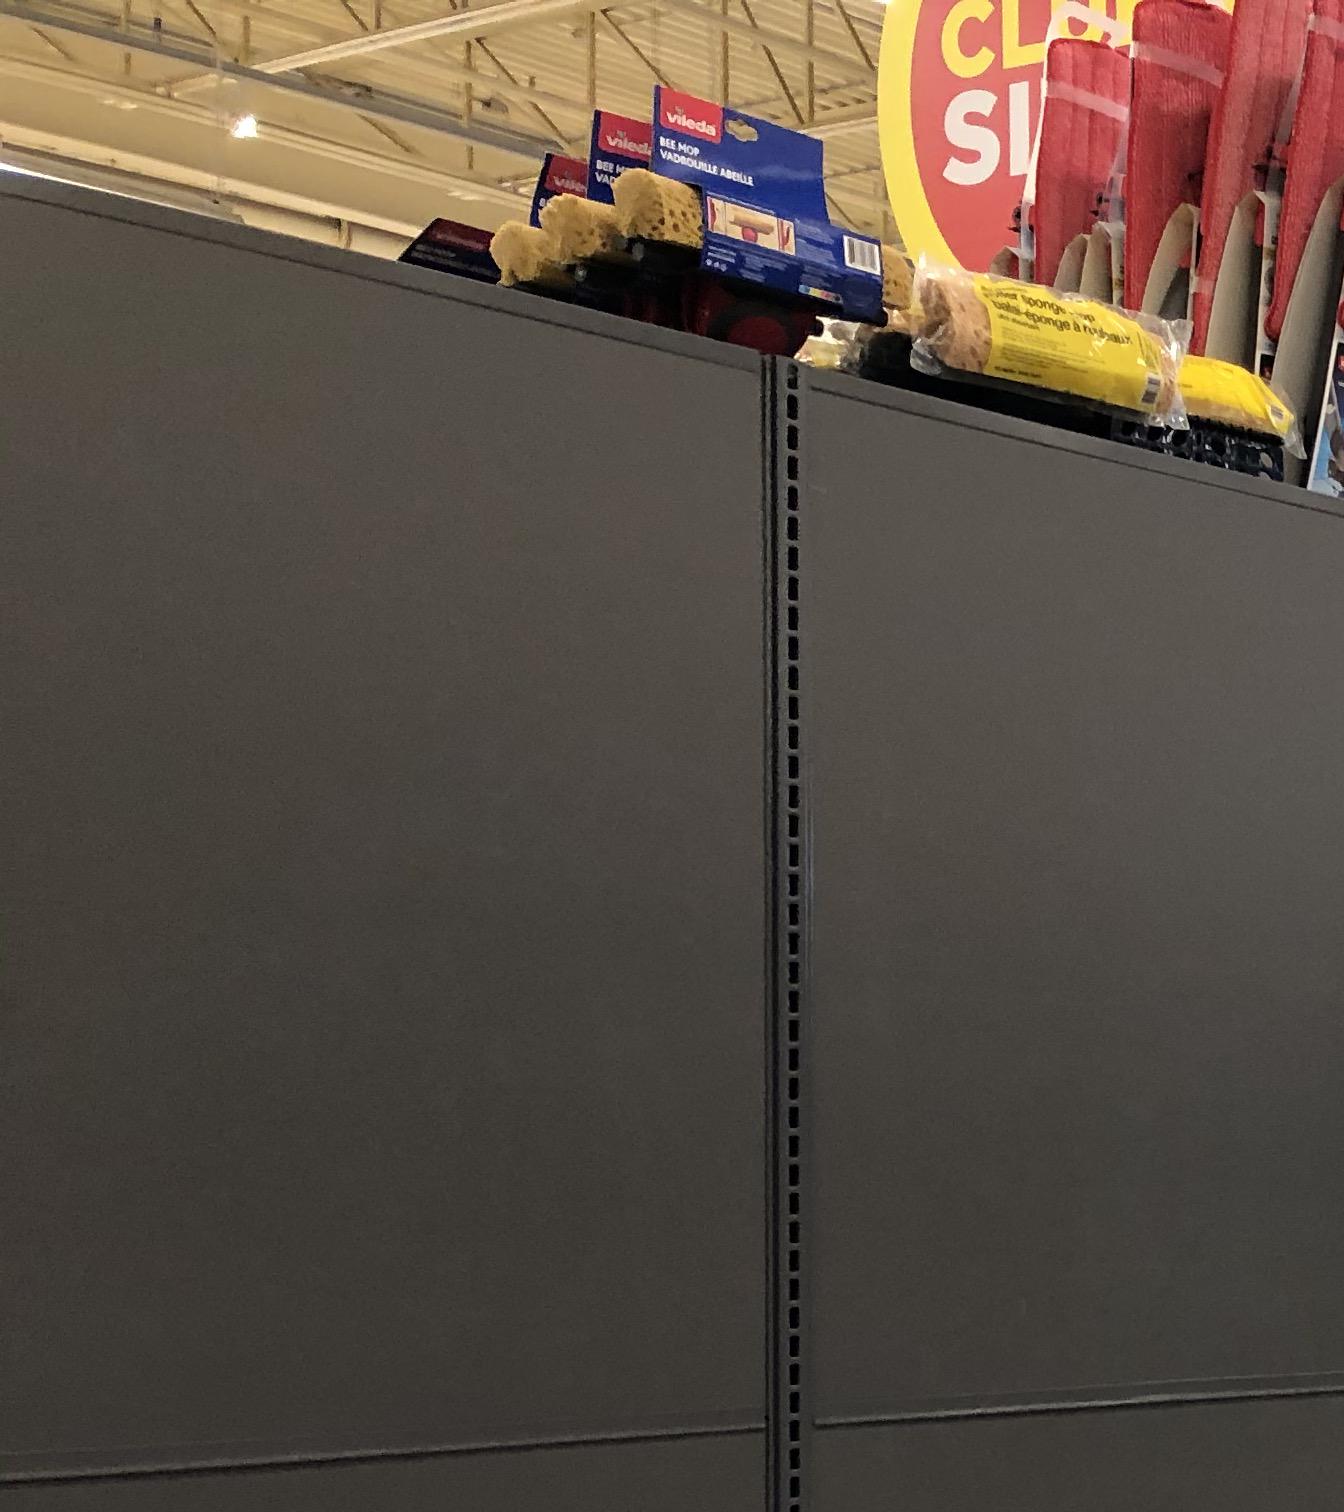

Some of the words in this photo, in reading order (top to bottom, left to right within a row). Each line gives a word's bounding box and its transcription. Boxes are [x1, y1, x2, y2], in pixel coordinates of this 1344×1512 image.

[666, 111, 716, 137] vileda
[606, 135, 651, 155] viled
[660, 137, 676, 150] BEE
[678, 142, 700, 156] MOP
